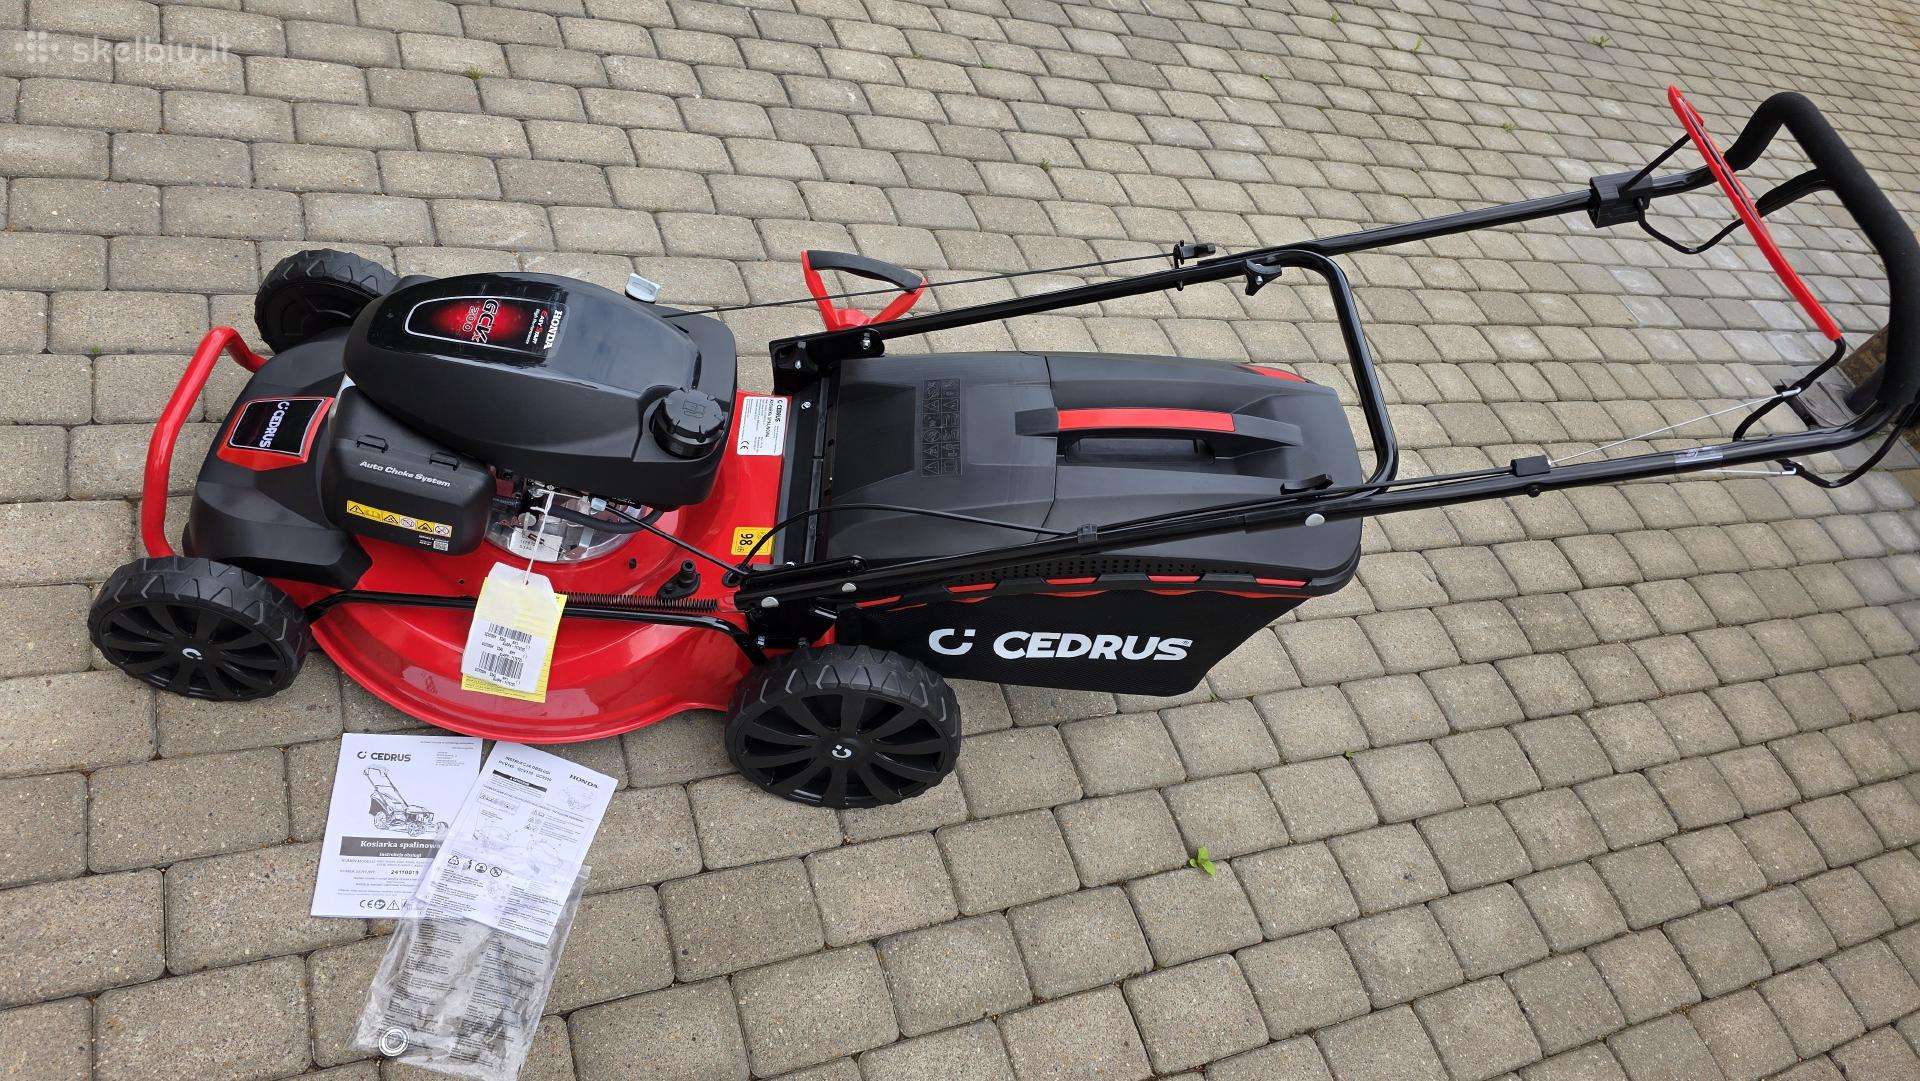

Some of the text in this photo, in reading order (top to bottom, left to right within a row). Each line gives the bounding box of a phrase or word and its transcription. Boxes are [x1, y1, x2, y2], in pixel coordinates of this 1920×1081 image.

[543, 309, 563, 350] HONDA
[259, 410, 286, 448] CEDRUS
[359, 460, 451, 488] Auto Choke System
[739, 533, 754, 546] 98
[992, 630, 1194, 661] CEDRUS
[370, 751, 412, 763] CEDRUS
[568, 773, 599, 789] HONDA
[359, 839, 398, 849] Kosiarka
